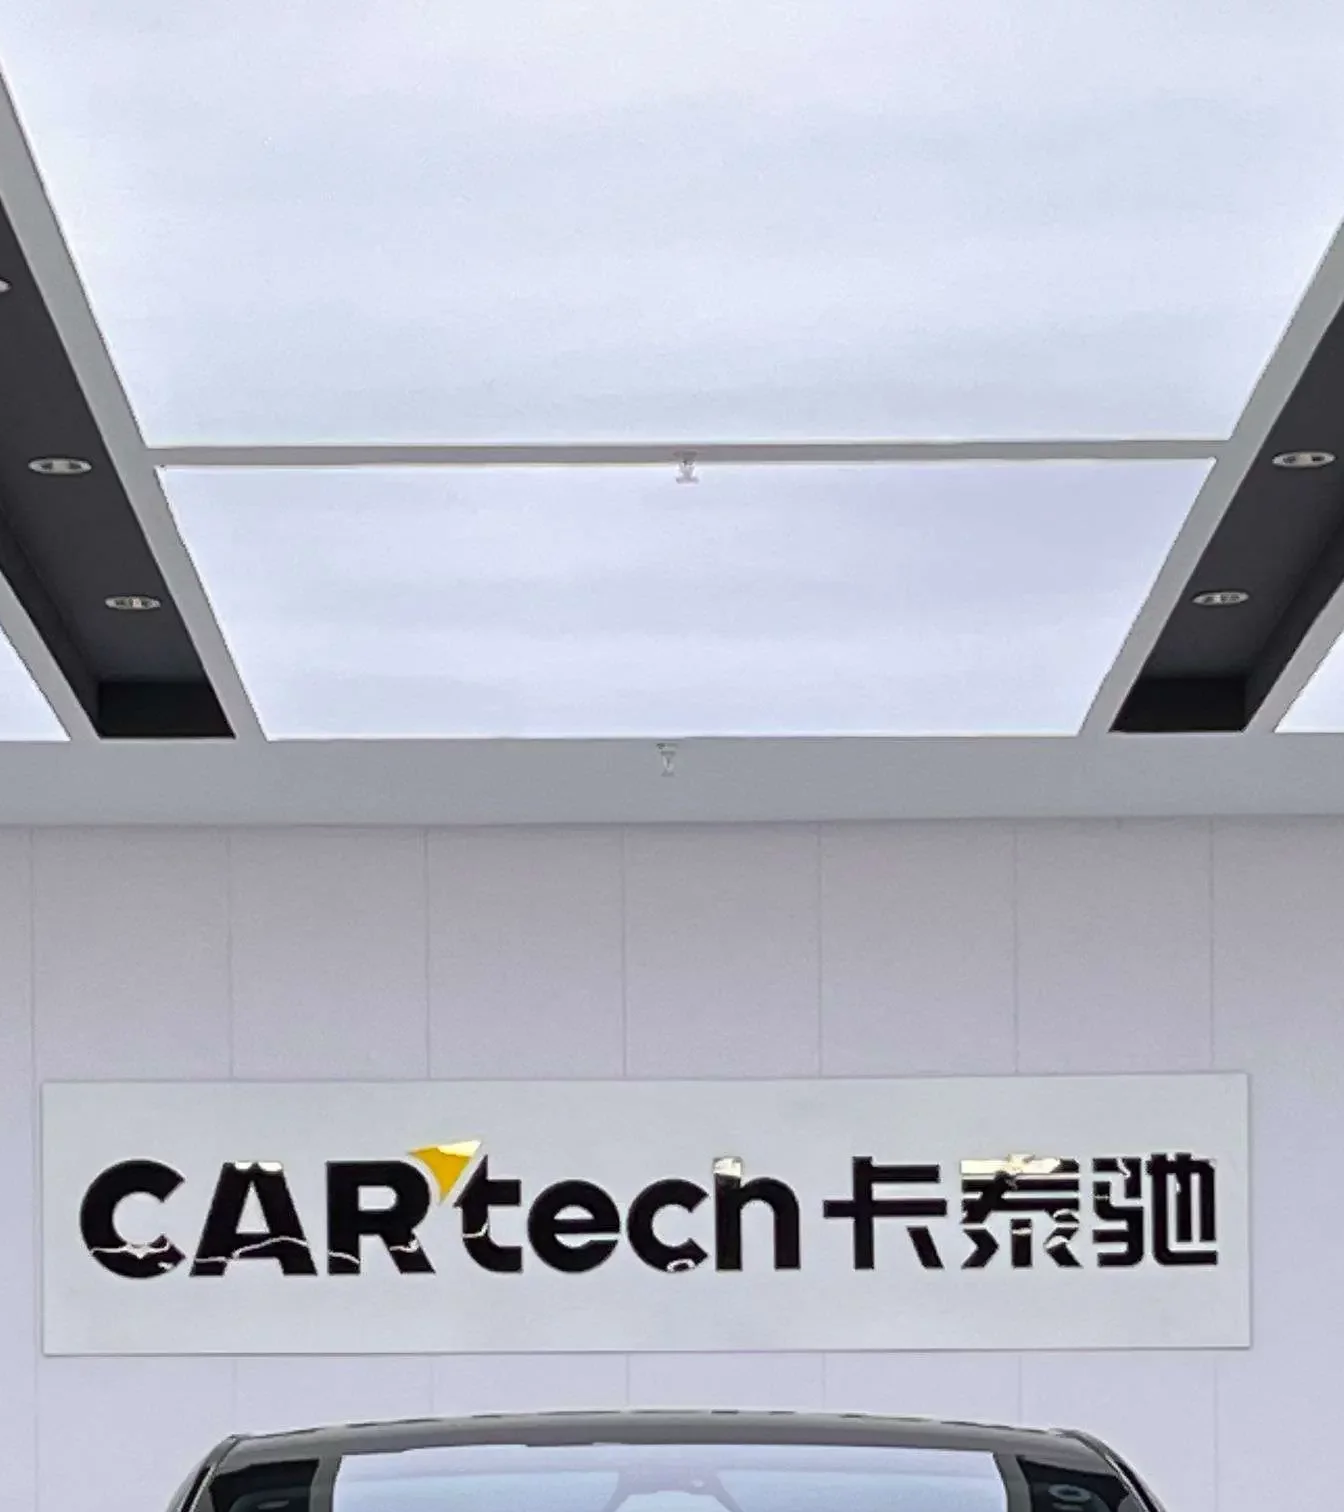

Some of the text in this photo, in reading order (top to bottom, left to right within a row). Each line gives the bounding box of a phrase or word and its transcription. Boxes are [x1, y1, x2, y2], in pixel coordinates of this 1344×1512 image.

[80, 1153, 1218, 1279] CARtech 卡泰驰
